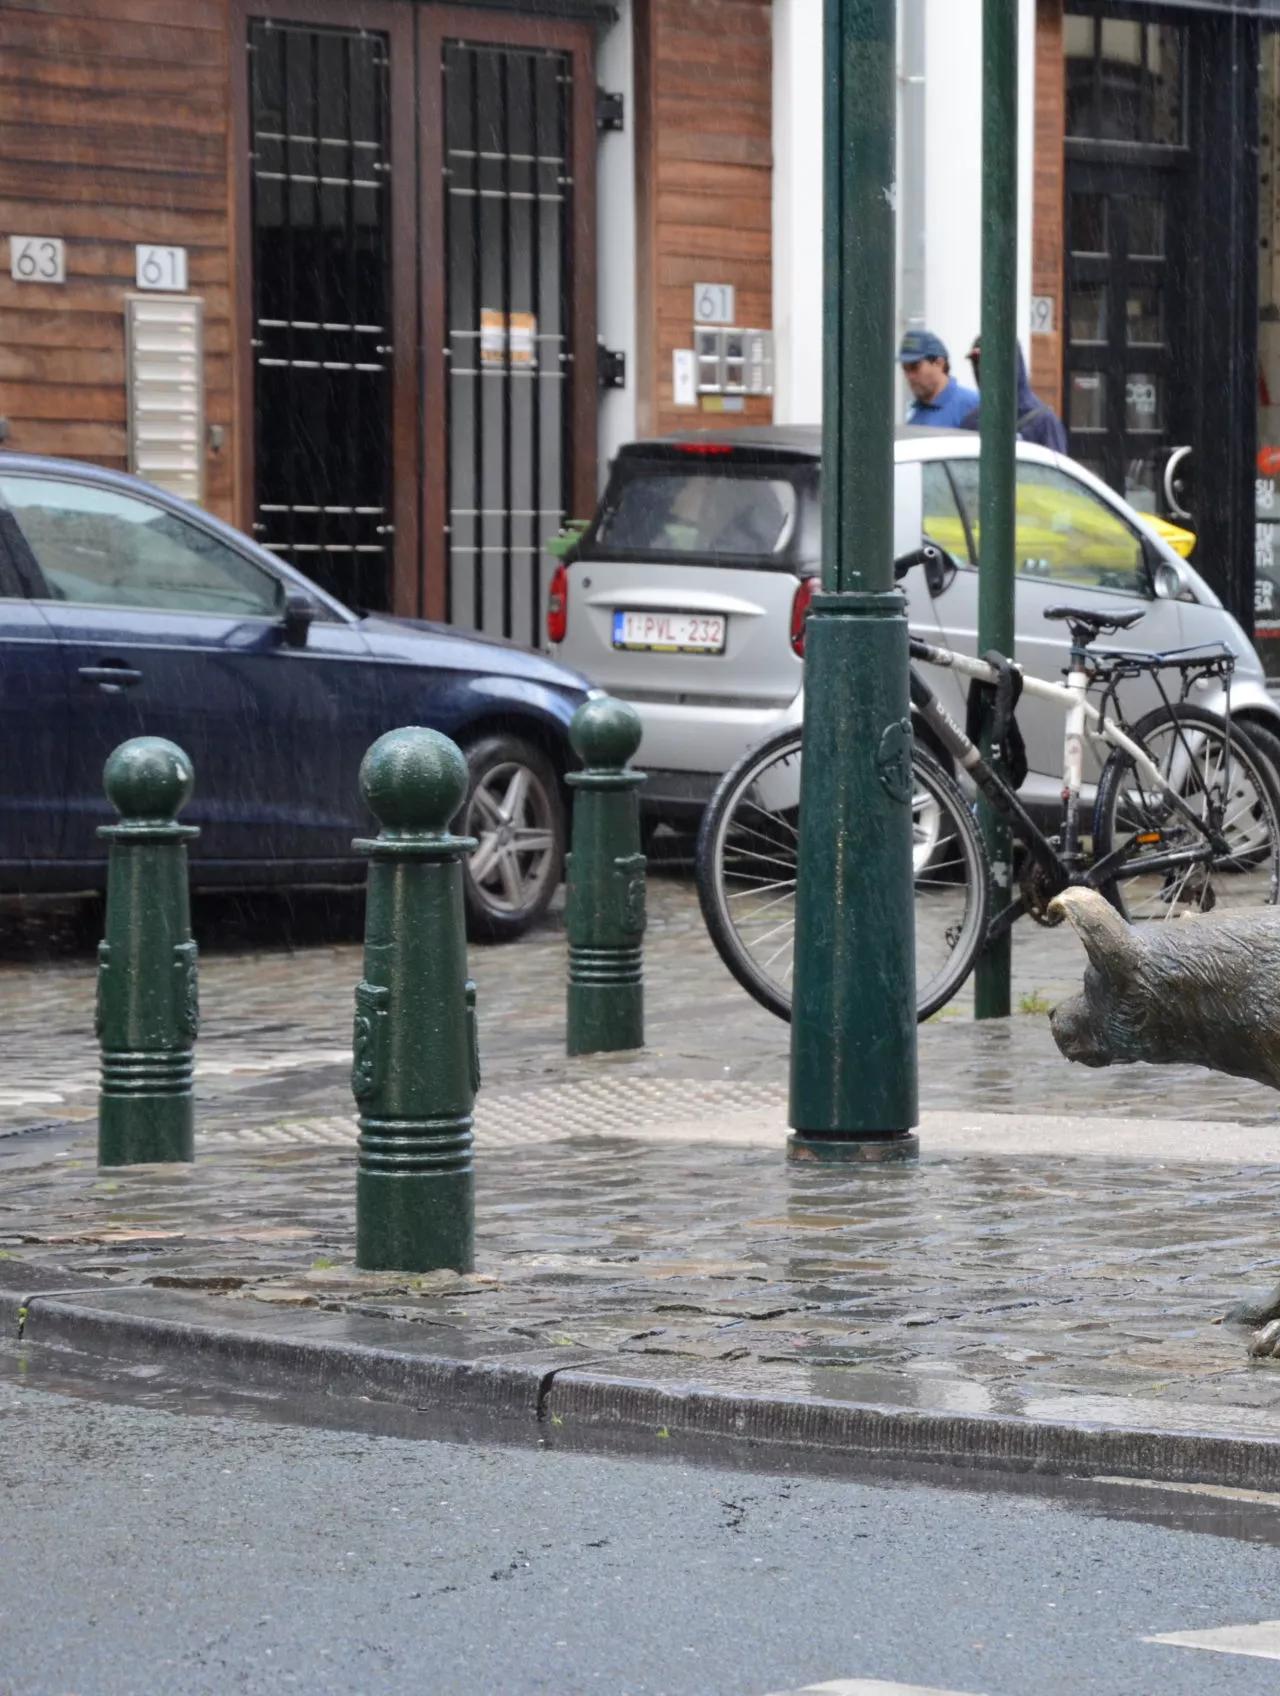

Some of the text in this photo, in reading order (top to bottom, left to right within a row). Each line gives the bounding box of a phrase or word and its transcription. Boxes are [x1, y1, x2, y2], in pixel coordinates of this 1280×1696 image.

[16, 242, 58, 278] 63
[142, 250, 178, 285] 61
[699, 287, 727, 319] 61
